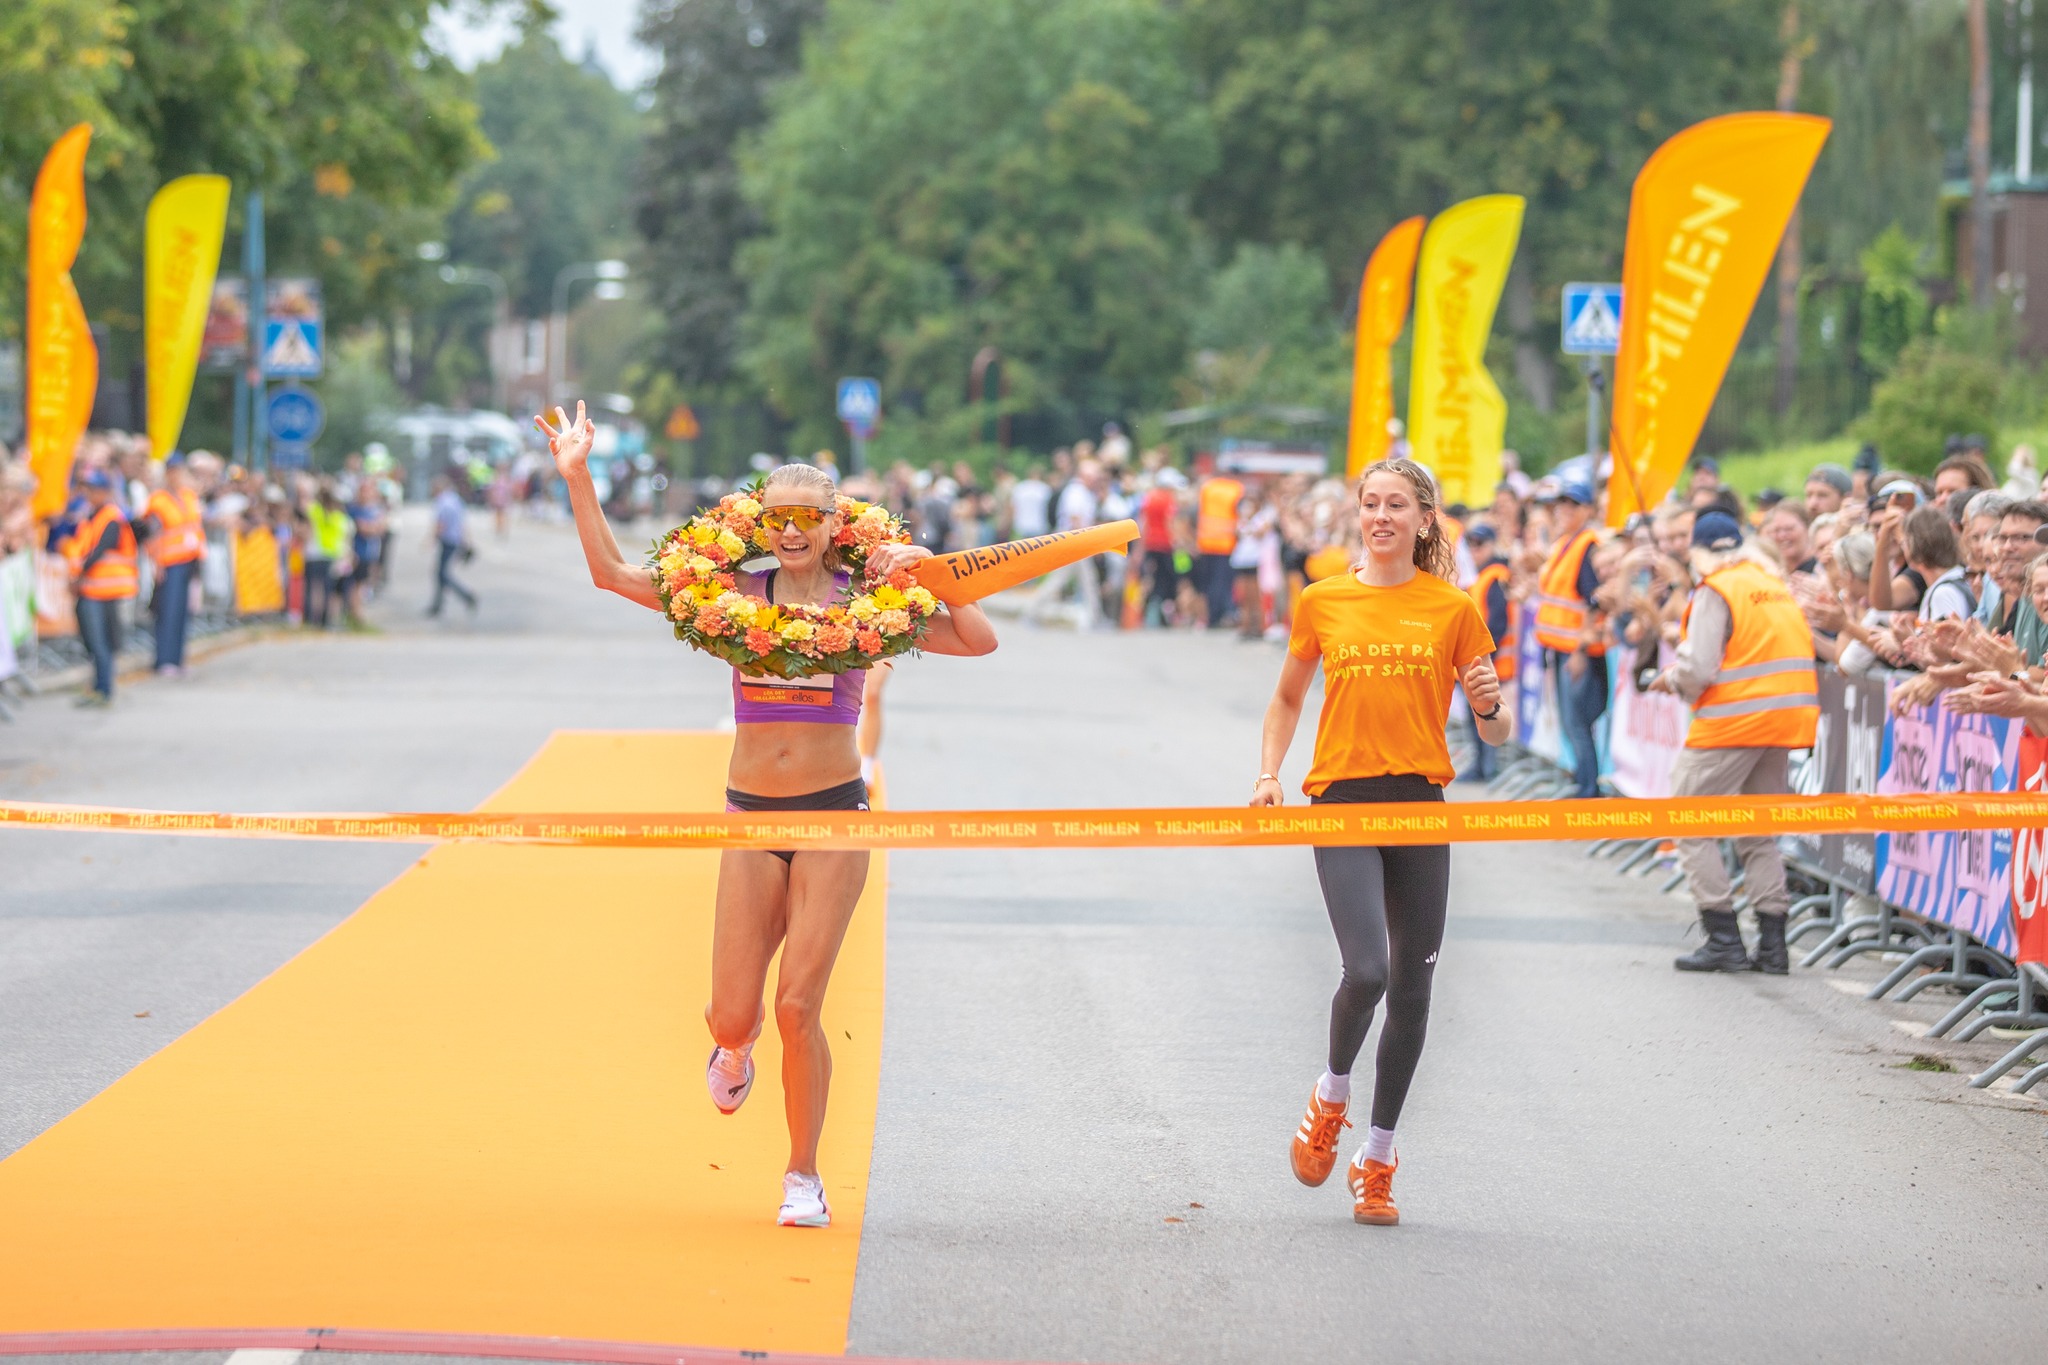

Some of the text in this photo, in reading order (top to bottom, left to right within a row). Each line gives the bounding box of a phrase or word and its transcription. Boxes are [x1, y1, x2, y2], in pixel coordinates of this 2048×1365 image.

[1634, 184, 1742, 474] MILEN
[947, 532, 1066, 580] TJEJMILEN
[1331, 642, 1434, 664] GÖR DET PÅ
[1333, 661, 1433, 682] MITT SÄTT.
[792, 692, 814, 703] ellos
[25, 810, 111, 825] TJEJMILEN
[128, 813, 215, 828] TJEJMILEN
[231, 816, 317, 832] TJEJMILEN
[333, 820, 420, 835] TJEJMILEN
[437, 823, 523, 837] TJEJMILEN
[539, 824, 626, 839] TJEJMILEN
[641, 825, 728, 838] TJEJMILEN
[745, 825, 832, 838] TJEJMILEN
[847, 824, 934, 838] TJEJMILEN
[949, 823, 1036, 837] TJEJMILEN
[1052, 821, 1140, 836] TJEJMILEN
[1155, 819, 1242, 834] TJEJMILEN
[1257, 817, 1344, 833] TJEJMILEN
[1360, 815, 1448, 831] TJEJMILEN
[1463, 813, 1550, 829] TJEJMILEN
[1565, 811, 1652, 827] TJEJMILEN
[1667, 808, 1755, 825] TJEJMILEN
[1769, 806, 1857, 822] TJEJMILEN
[1871, 804, 1958, 820] TJEJMILEN
[1973, 802, 2048, 818] TJEJMILE
